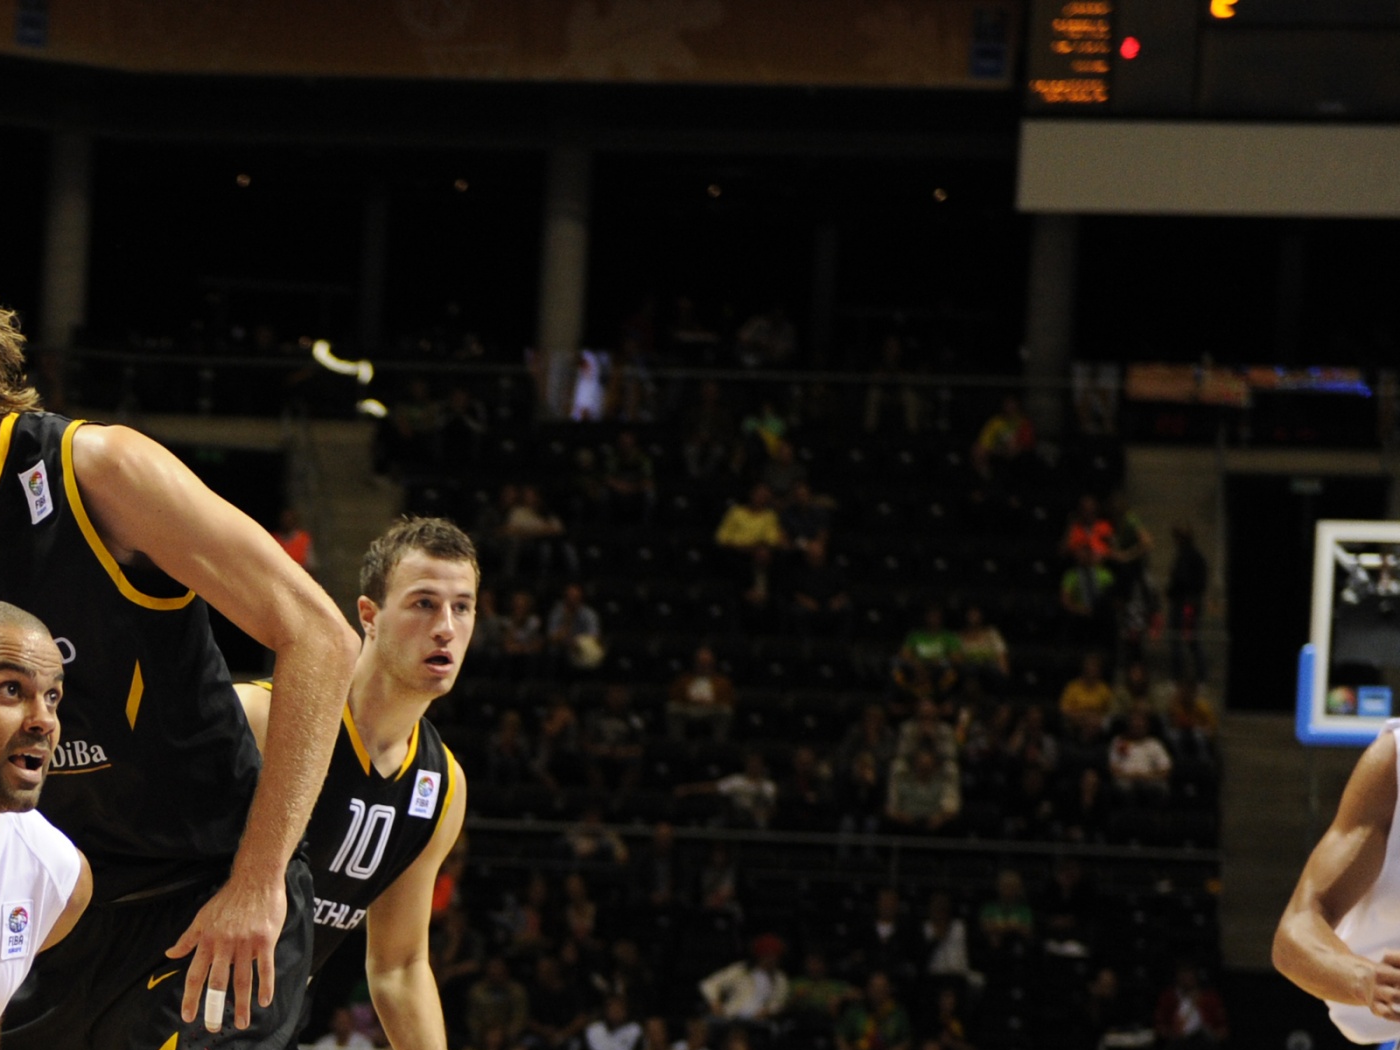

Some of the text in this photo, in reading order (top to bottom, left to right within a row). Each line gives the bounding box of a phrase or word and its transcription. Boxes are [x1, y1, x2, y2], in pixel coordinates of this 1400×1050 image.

[52, 740, 108, 768] DiBa
[329, 798, 396, 880] 10
[8, 935, 24, 946] FIBA
